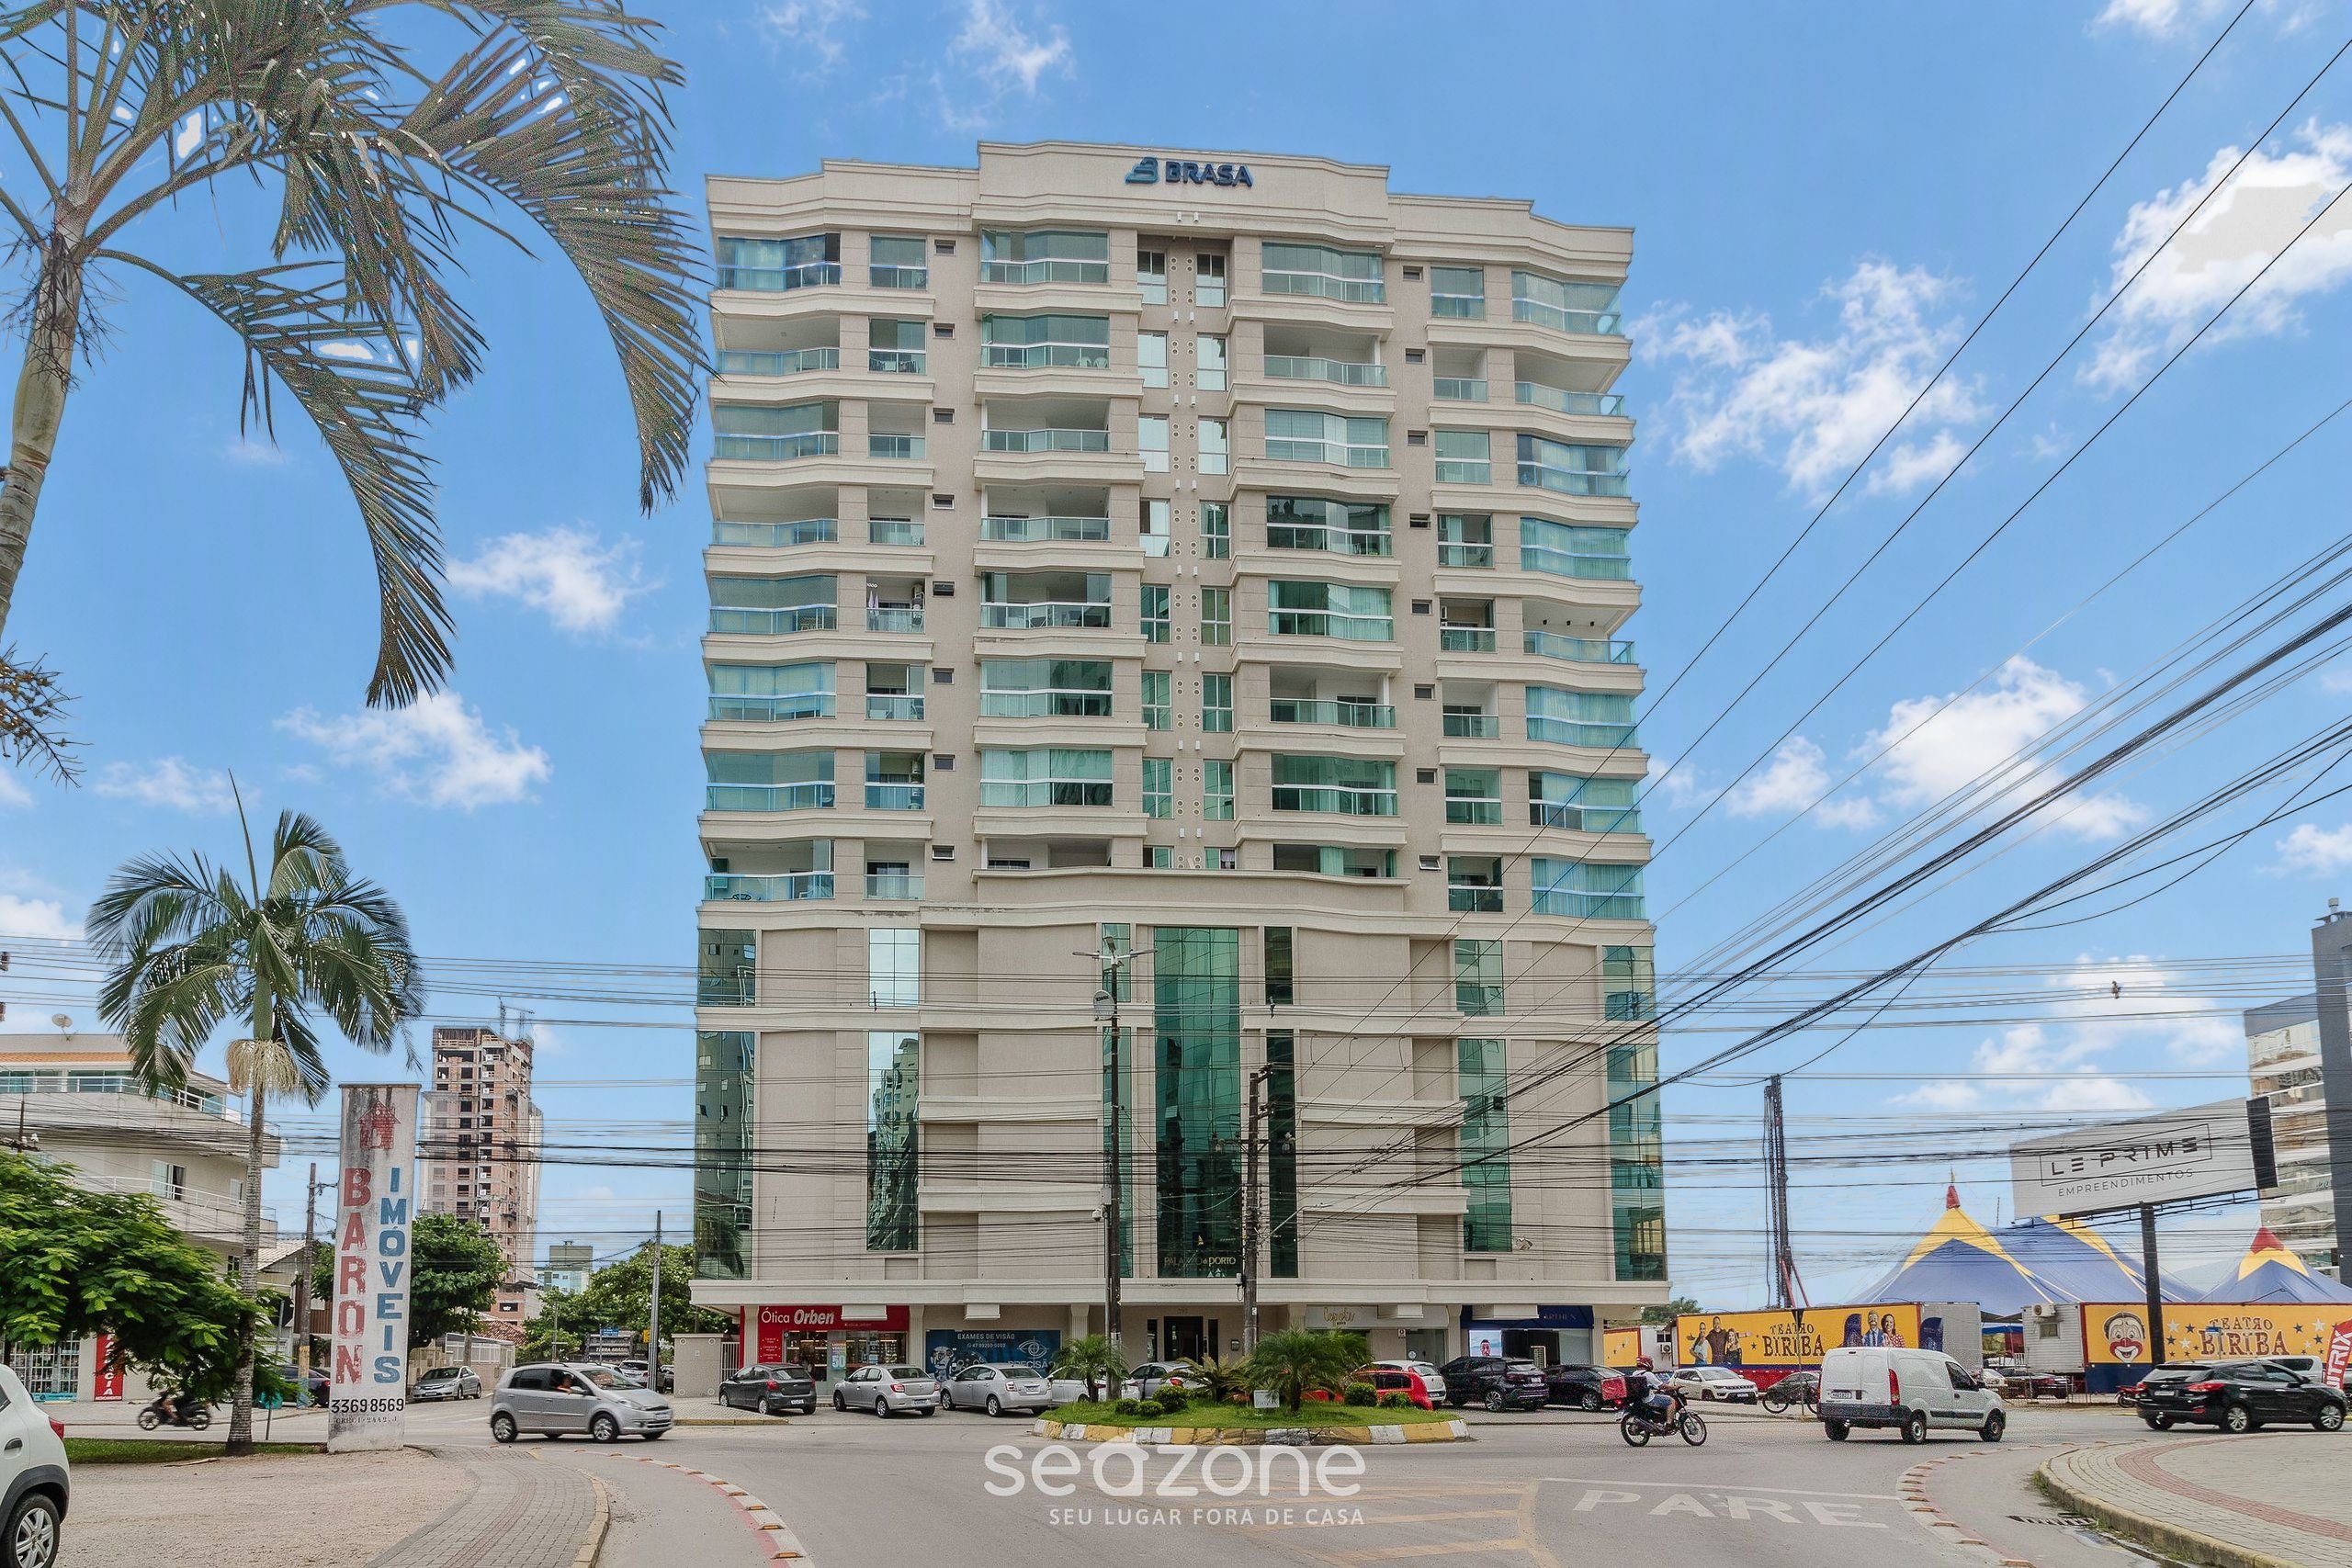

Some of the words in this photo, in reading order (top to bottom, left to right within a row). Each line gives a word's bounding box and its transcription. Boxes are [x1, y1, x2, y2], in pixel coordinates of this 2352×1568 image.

[1165, 161, 1252, 187] BRASA
[2058, 1168, 2193, 1197] EMPREENDIMENTOS
[1208, 1256, 1237, 1268] PORTO
[335, 1168, 372, 1384] BARON
[373, 1167, 407, 1384] IMÓVEIS
[761, 1306, 790, 1323] Ótica
[794, 1308, 835, 1325] Orben
[1762, 1334, 1826, 1357] BIRIBA
[2198, 1330, 2290, 1356] BIRIBA
[1572, 1489, 1890, 1529] PARE
